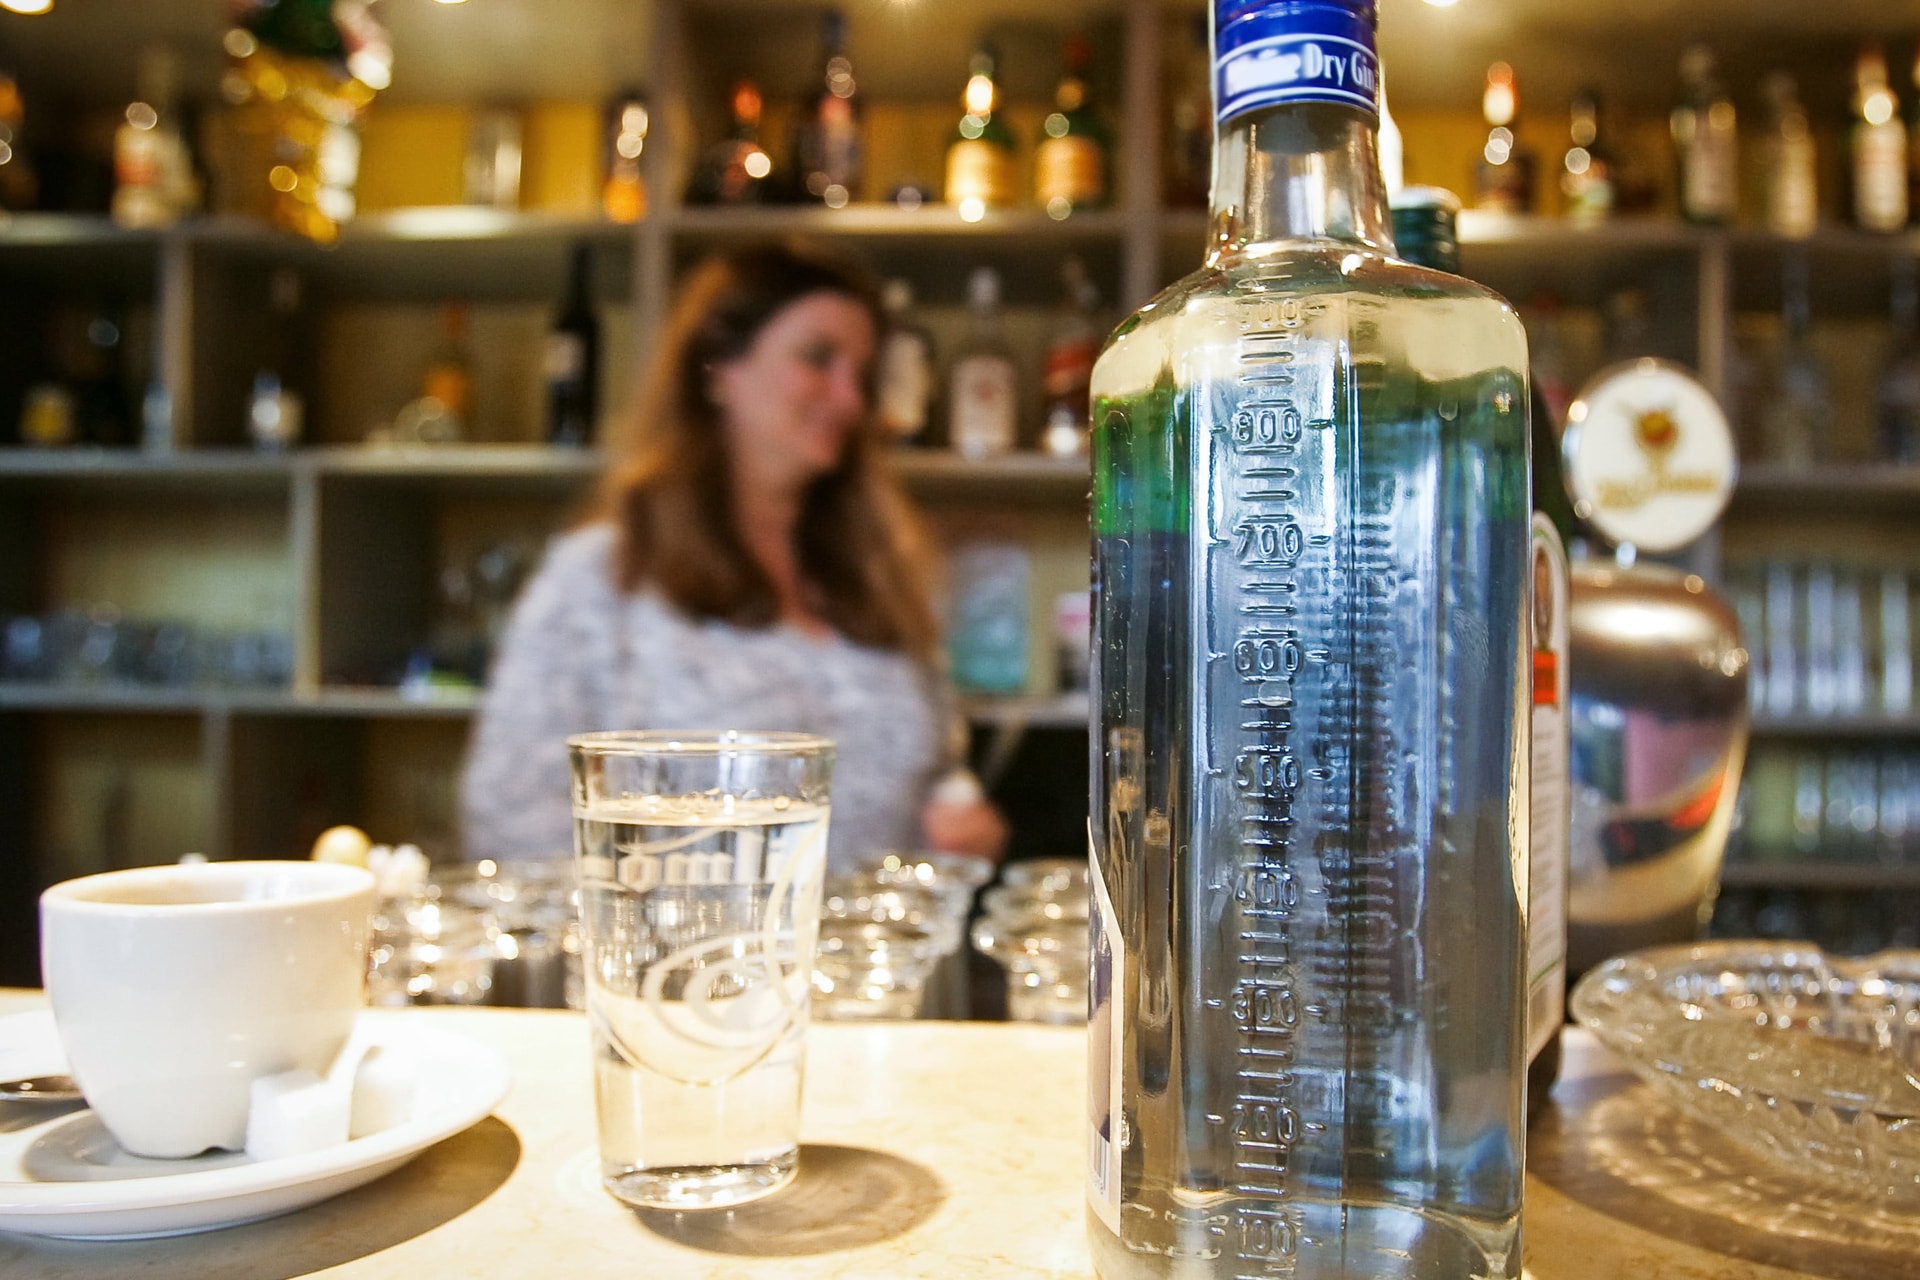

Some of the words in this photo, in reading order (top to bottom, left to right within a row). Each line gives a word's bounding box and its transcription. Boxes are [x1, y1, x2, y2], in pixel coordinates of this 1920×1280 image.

[1303, 42, 1347, 87] Dry
[1351, 50, 1375, 91] Gin
[1232, 408, 1300, 444] 800
[1233, 523, 1302, 559] 700
[1234, 639, 1300, 675] 600
[1234, 754, 1300, 791] 500
[1232, 987, 1297, 1026] 300
[1231, 1104, 1298, 1144] 200
[1238, 1217, 1296, 1257] 100
